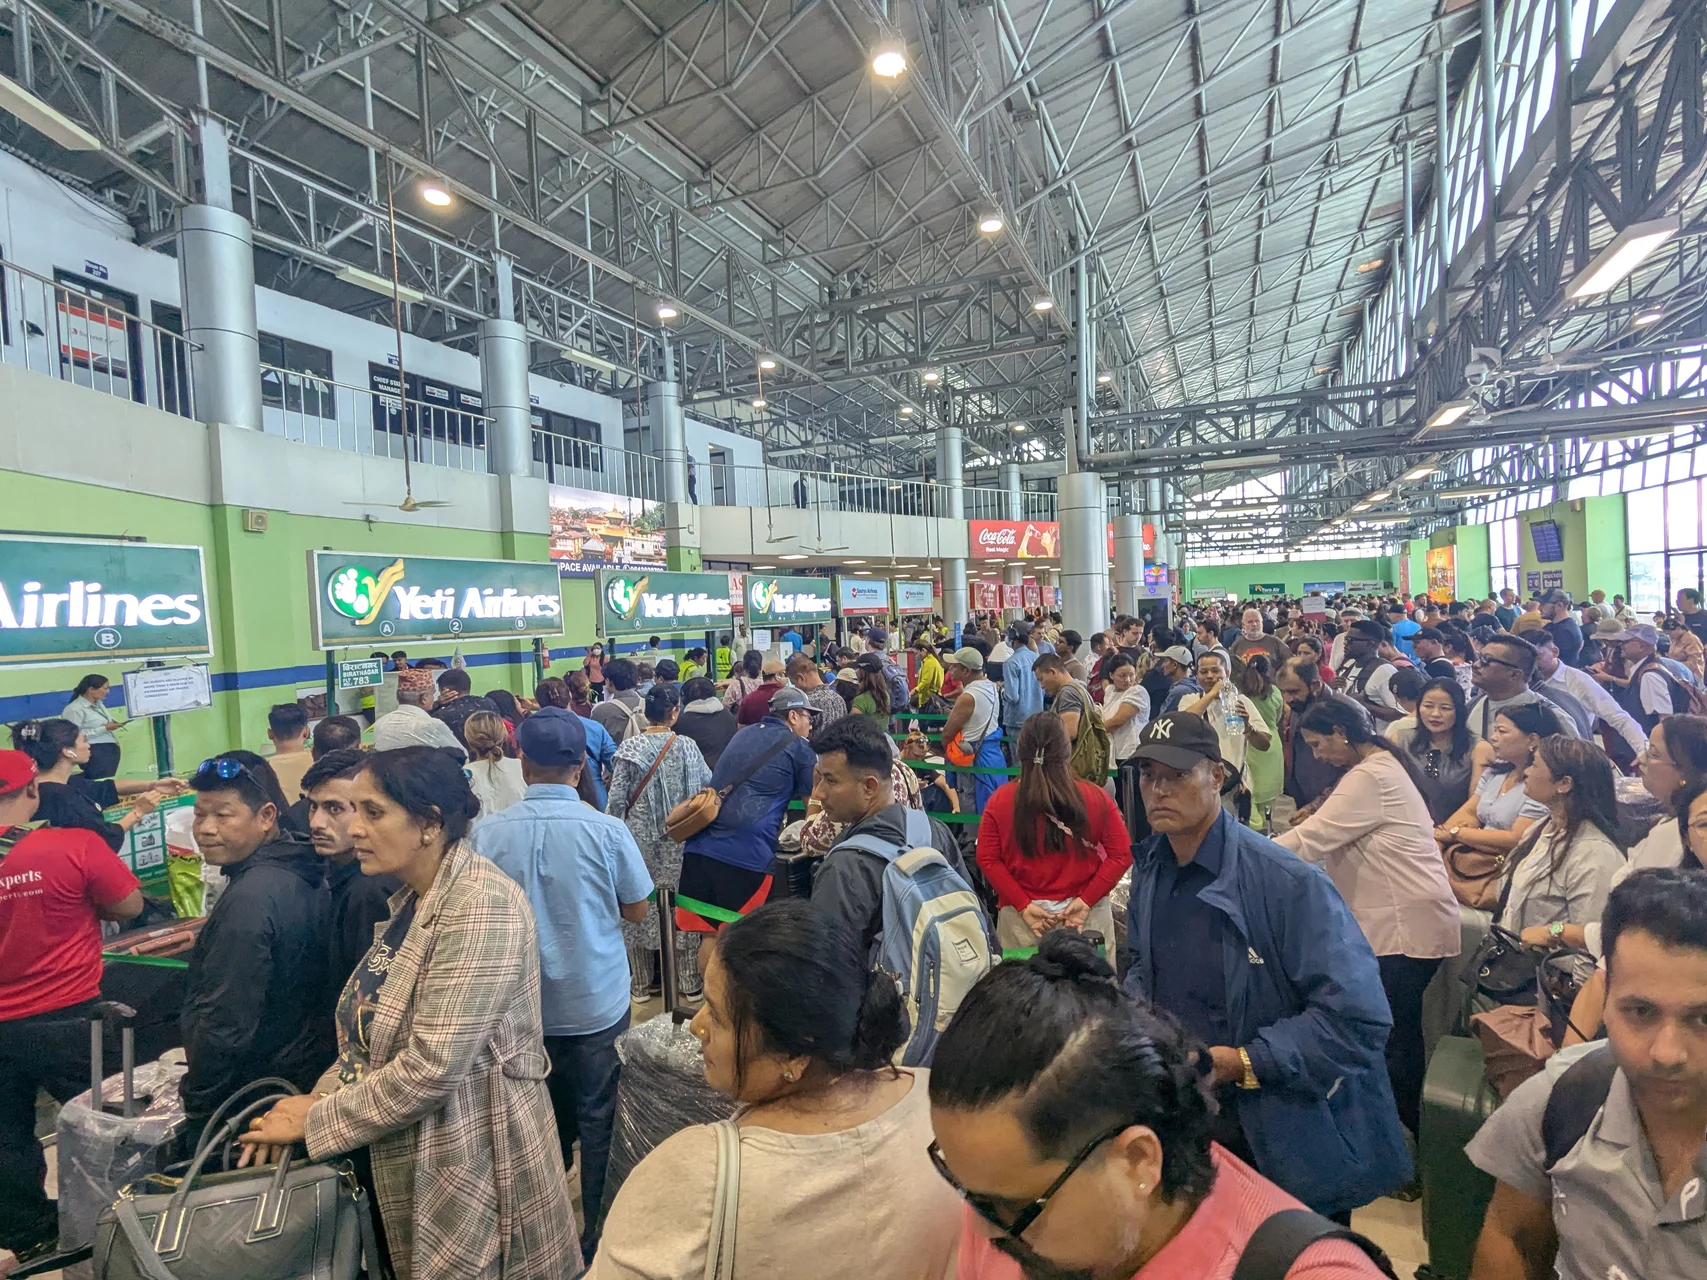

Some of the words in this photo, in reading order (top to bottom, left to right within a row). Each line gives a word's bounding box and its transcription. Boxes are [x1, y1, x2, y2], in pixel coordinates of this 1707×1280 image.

[373, 376, 389, 384] CHIEF
[378, 384, 402, 395] MANAGE
[558, 562, 581, 572] PACE
[392, 585, 455, 620] Yeti
[459, 587, 560, 618] Airlines
[382, 623, 391, 633] A
[452, 621, 460, 631] 2
[516, 618, 524, 628] B
[101, 633, 115, 645] B
[342, 669, 379, 678] BIRATNAGAR
[352, 676, 370, 686] 783
[1149, 718, 1174, 739] NY
